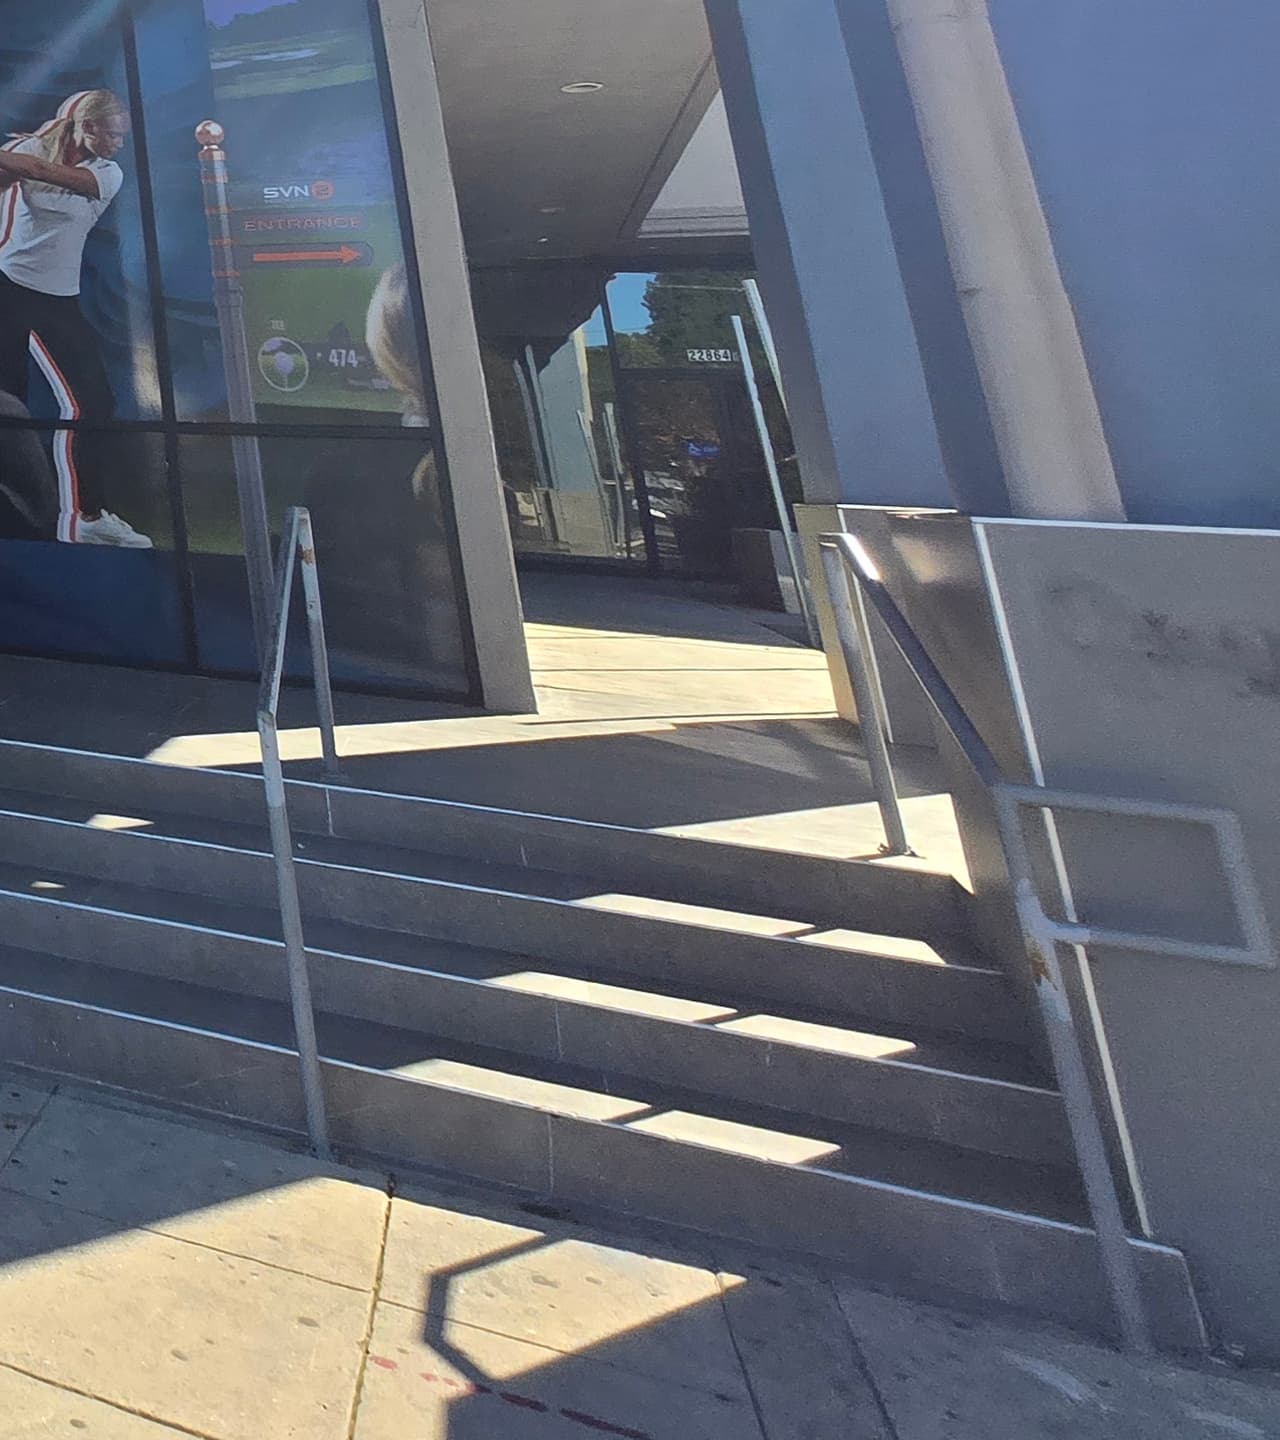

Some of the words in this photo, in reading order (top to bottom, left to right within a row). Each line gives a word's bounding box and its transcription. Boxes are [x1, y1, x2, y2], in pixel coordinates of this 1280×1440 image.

[263, 185, 310, 199] SVN
[244, 216, 361, 232] ENTRANCE
[328, 348, 359, 368] 474
